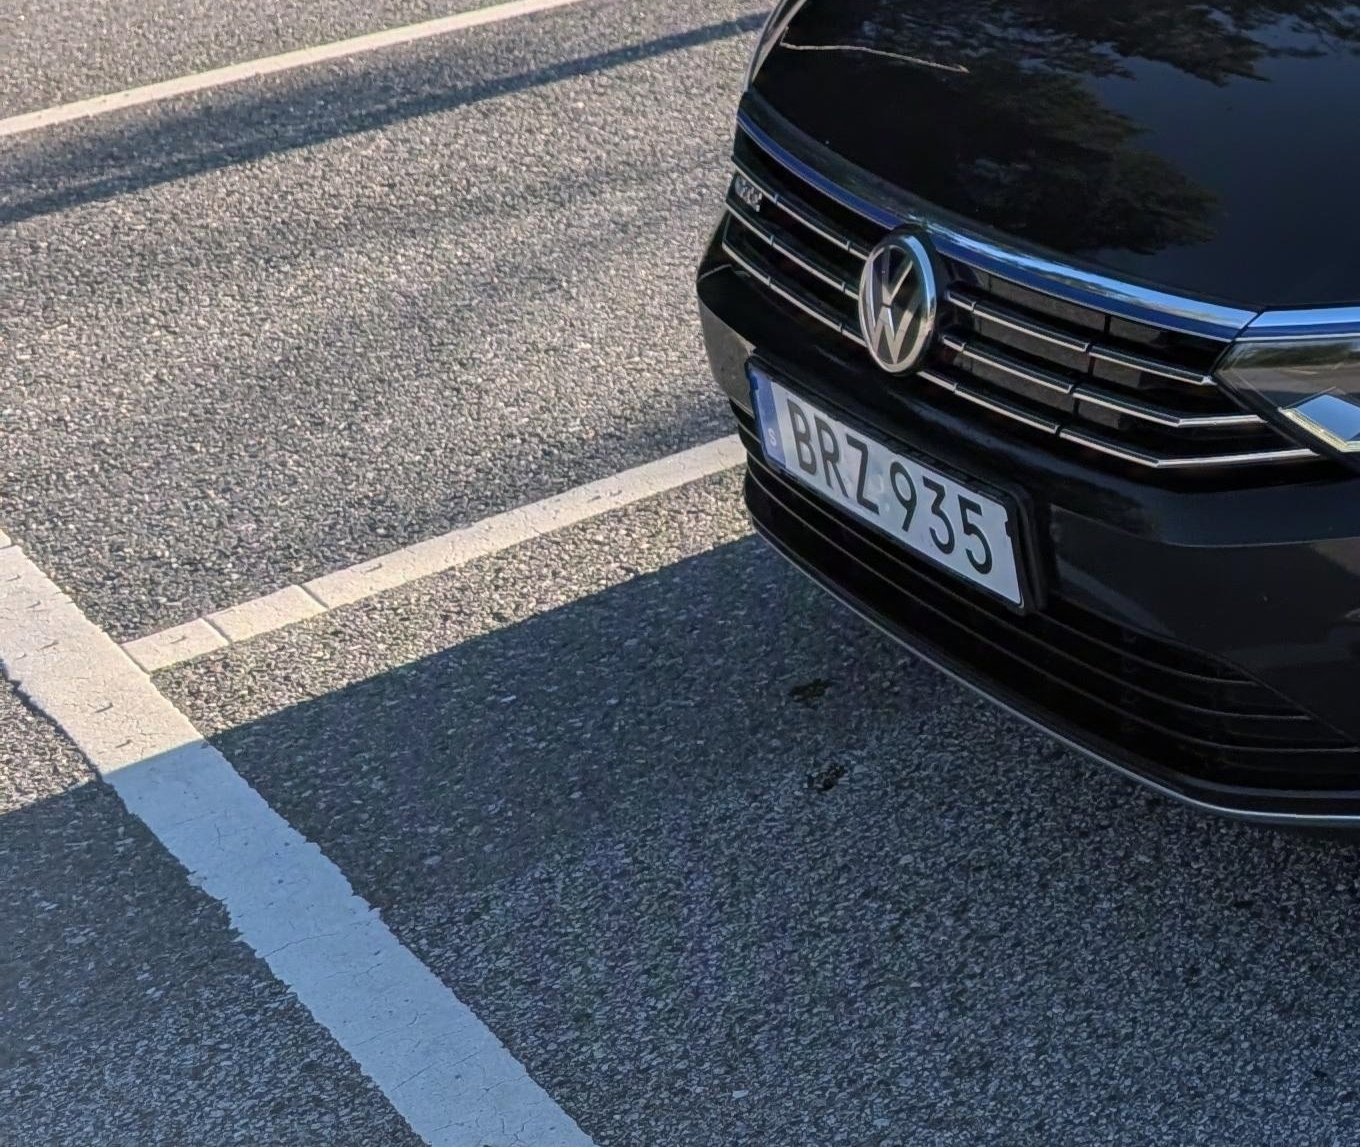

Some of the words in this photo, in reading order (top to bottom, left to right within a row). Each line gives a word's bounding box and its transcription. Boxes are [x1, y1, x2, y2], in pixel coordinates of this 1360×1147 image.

[768, 426, 777, 447] S
[786, 397, 880, 516] BRZ
[889, 461, 993, 575] 935
